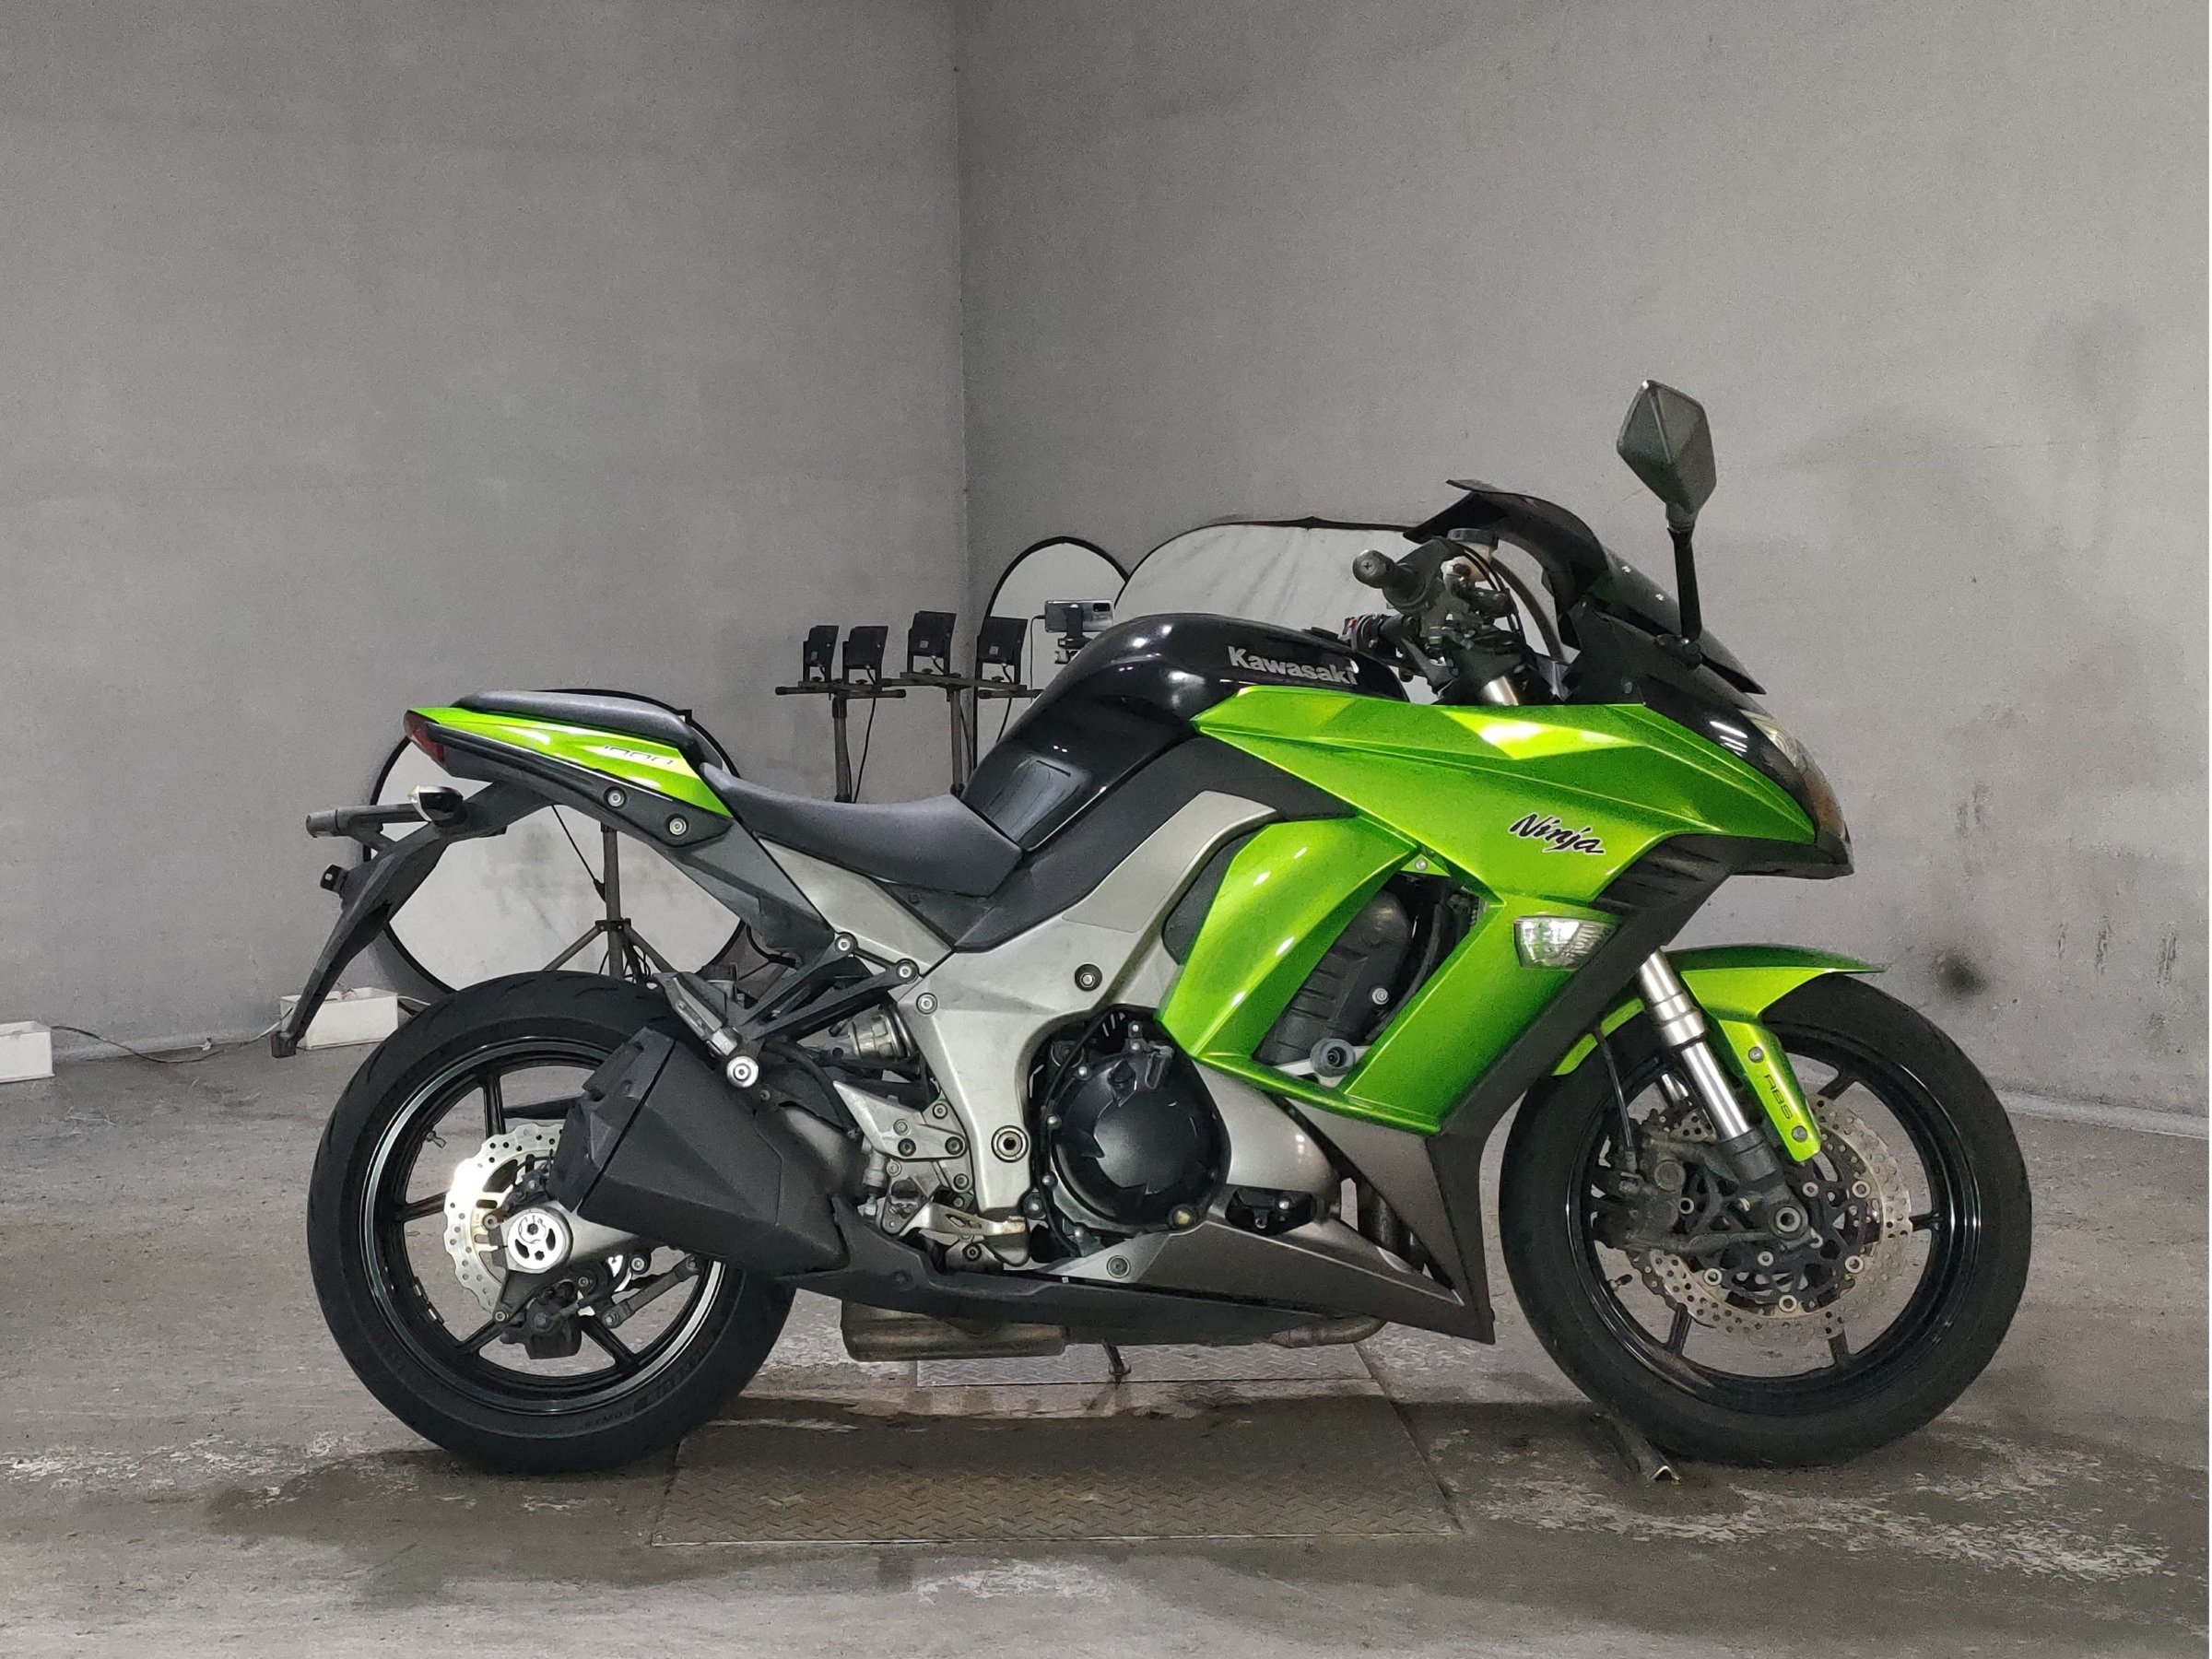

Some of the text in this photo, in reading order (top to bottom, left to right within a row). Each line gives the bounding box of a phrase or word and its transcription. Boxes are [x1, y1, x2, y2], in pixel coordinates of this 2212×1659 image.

[1228, 645, 1359, 686] Kawasaki
[1509, 812, 1606, 854] Ninja
[1763, 1074, 1793, 1120] ABS
